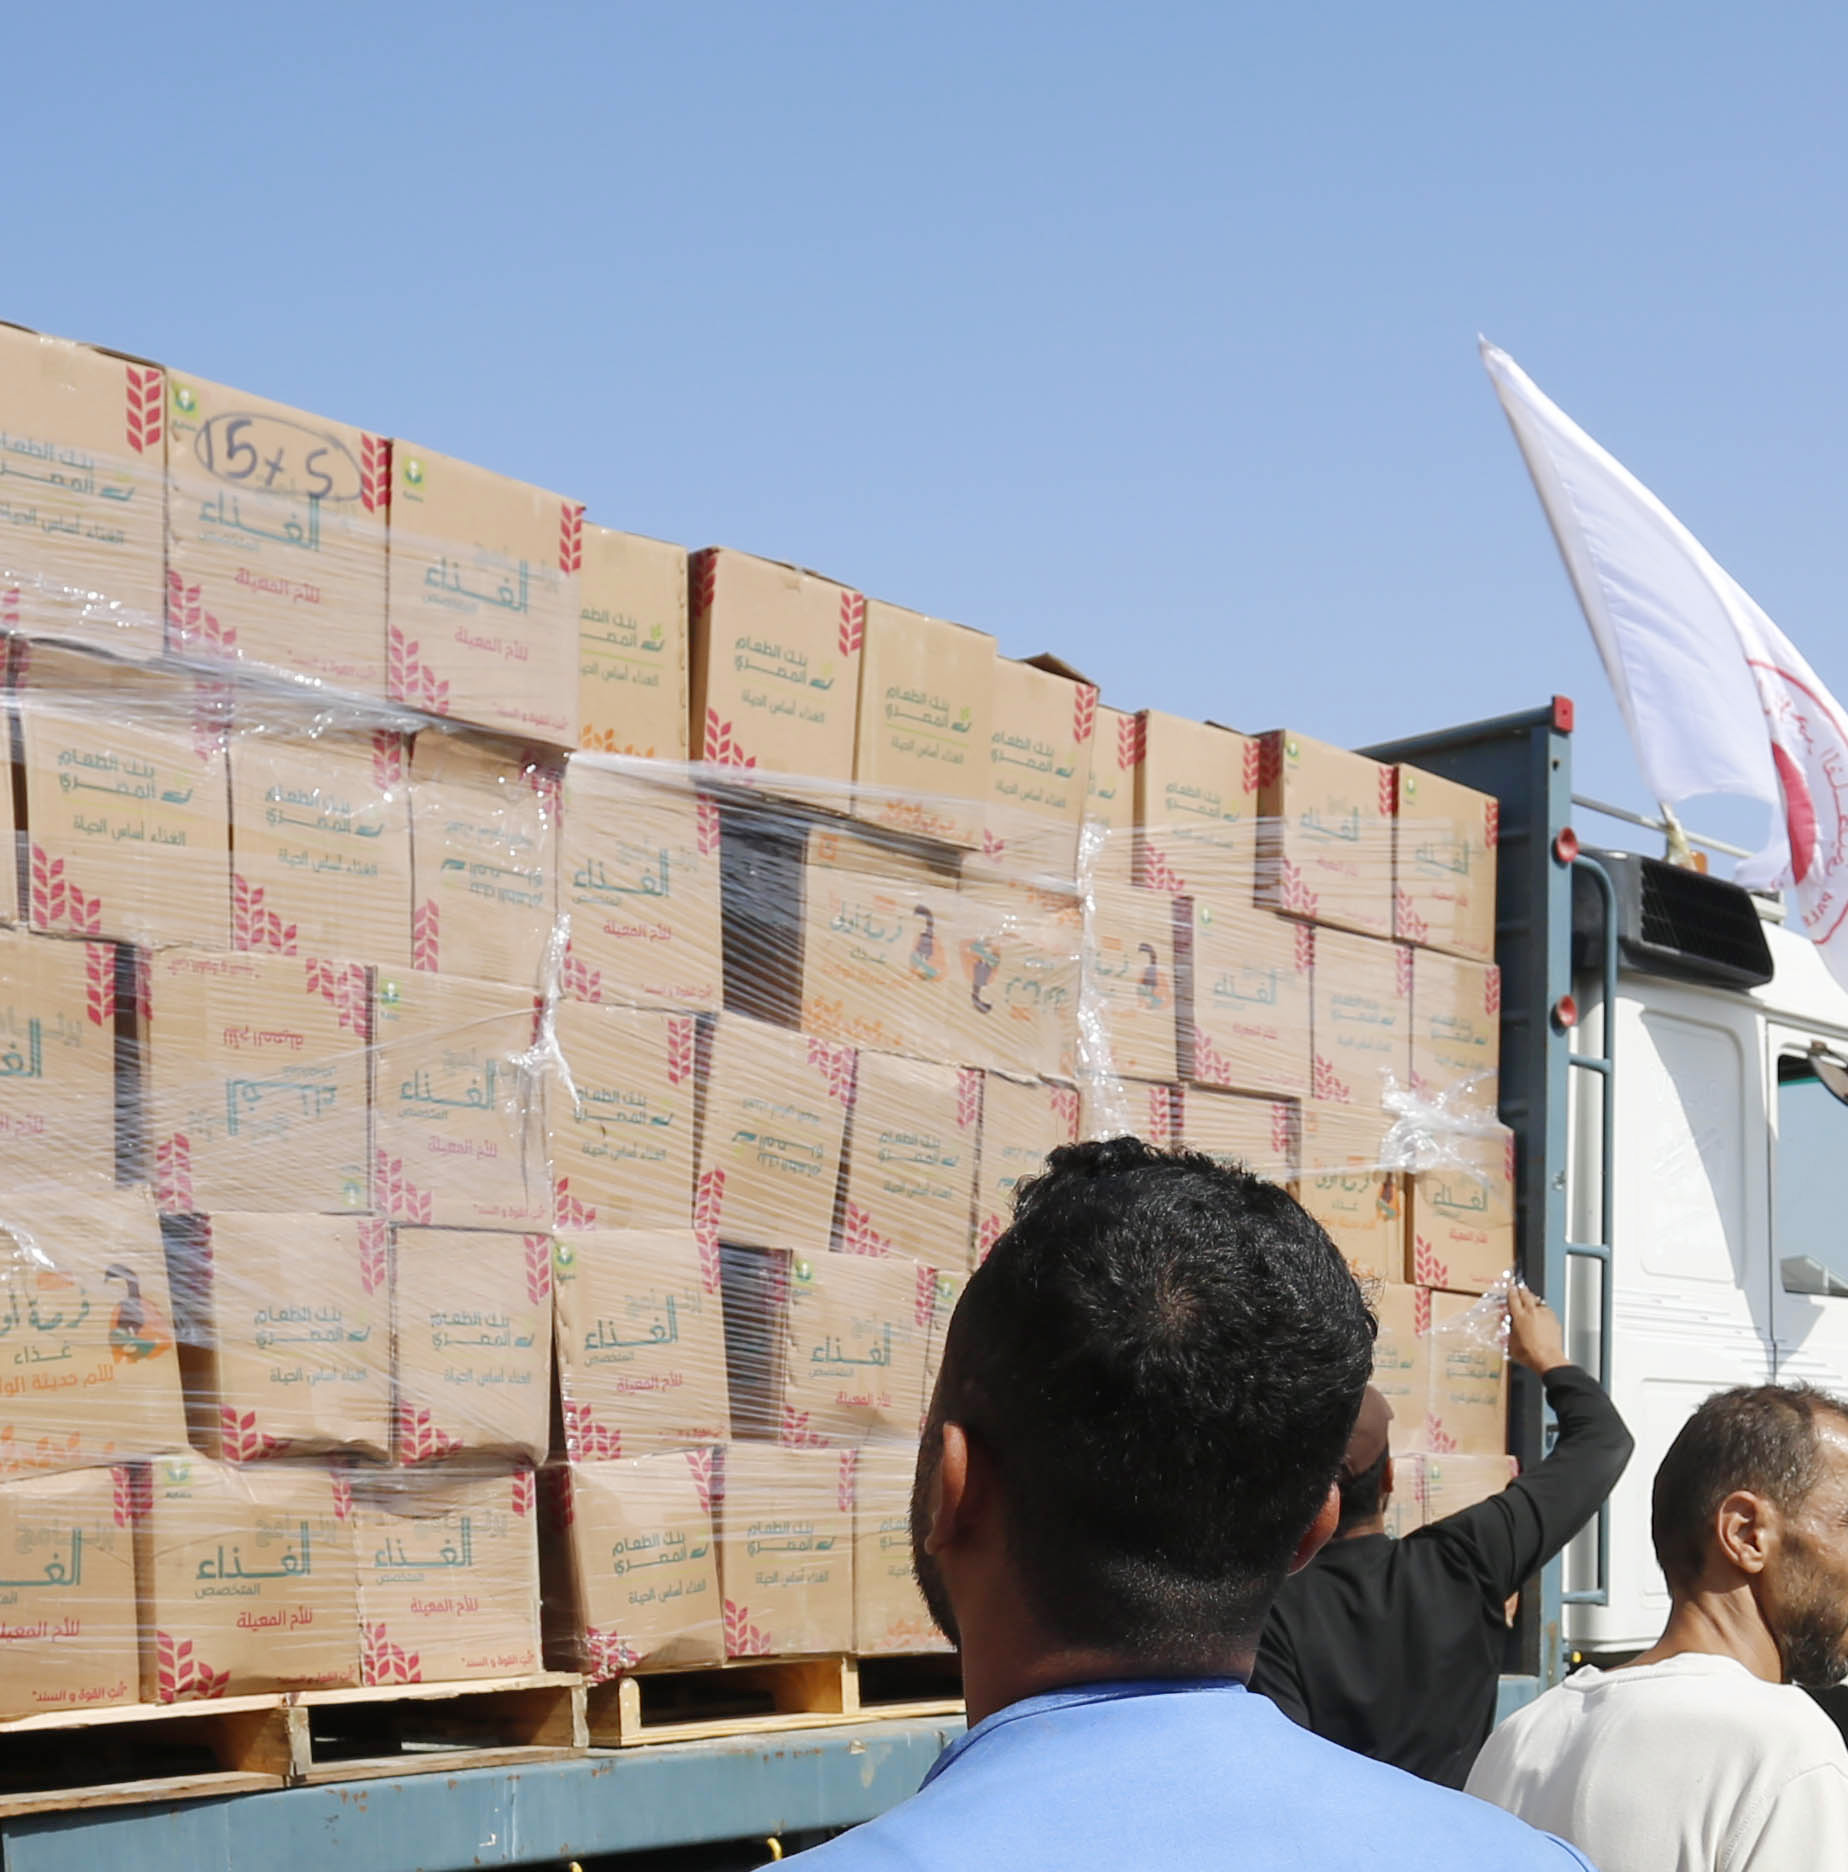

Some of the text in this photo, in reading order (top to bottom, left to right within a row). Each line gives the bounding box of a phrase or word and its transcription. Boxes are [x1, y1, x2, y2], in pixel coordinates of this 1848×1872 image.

[585, 1296, 678, 1349] الغذاء
[196, 1522, 310, 1580] الغذاء
[236, 1611, 285, 1629] المعيلة
